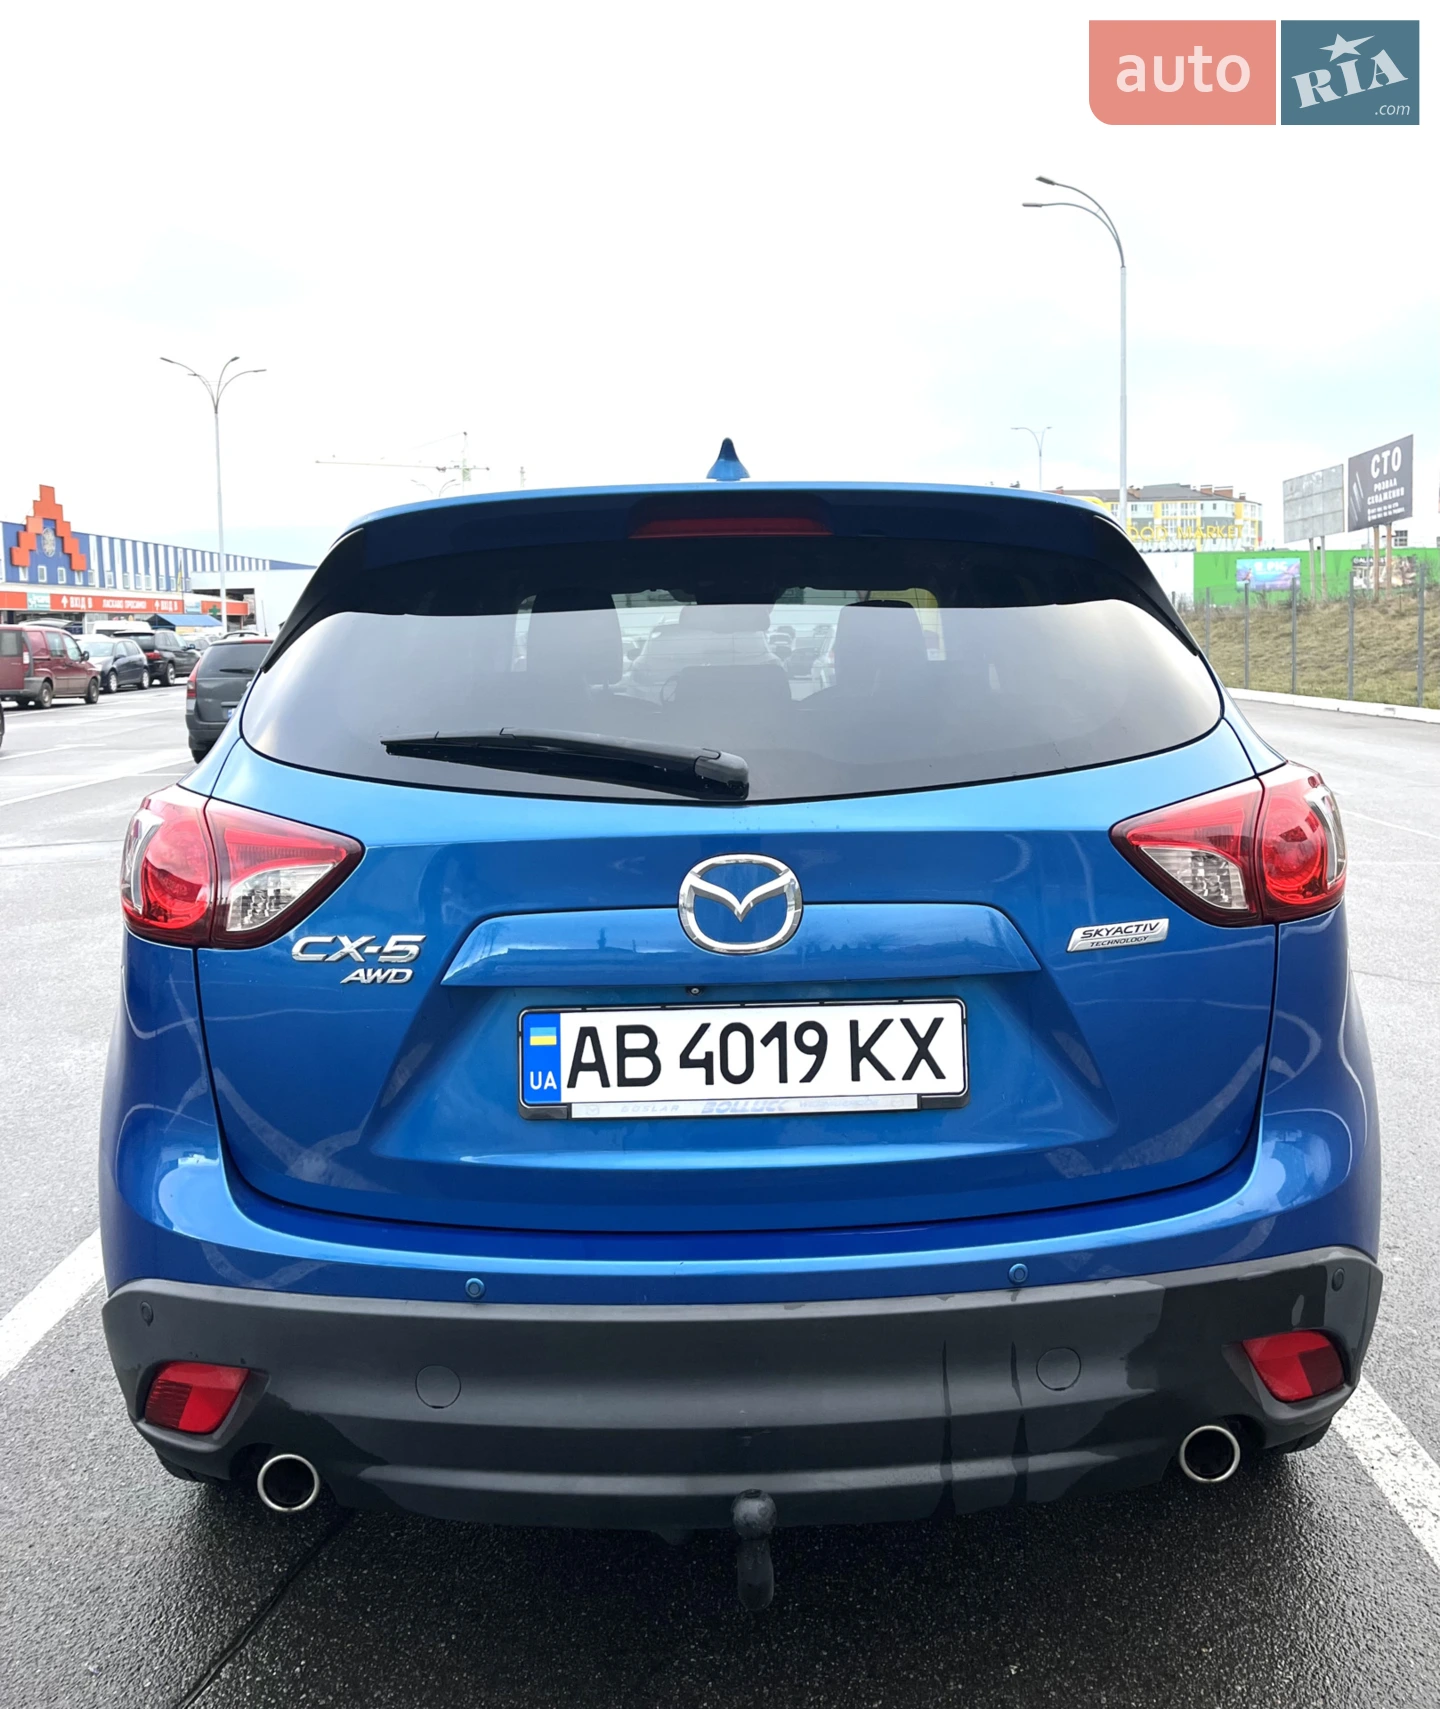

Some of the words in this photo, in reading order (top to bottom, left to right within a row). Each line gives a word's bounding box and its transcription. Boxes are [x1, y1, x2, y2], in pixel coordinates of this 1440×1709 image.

[1370, 446, 1402, 478] СТО
[1126, 526, 1168, 542] OOD
[1177, 524, 1244, 539] MARKET
[1081, 922, 1160, 939] SKYACTIV
[291, 934, 427, 963] CX-5
[1090, 935, 1149, 947] TECHNOLOGY
[340, 968, 414, 985] AWD
[566, 1024, 662, 1089] AB
[679, 1019, 829, 1086] 4019
[849, 1016, 947, 1082] KX
[529, 1072, 558, 1091] UA
